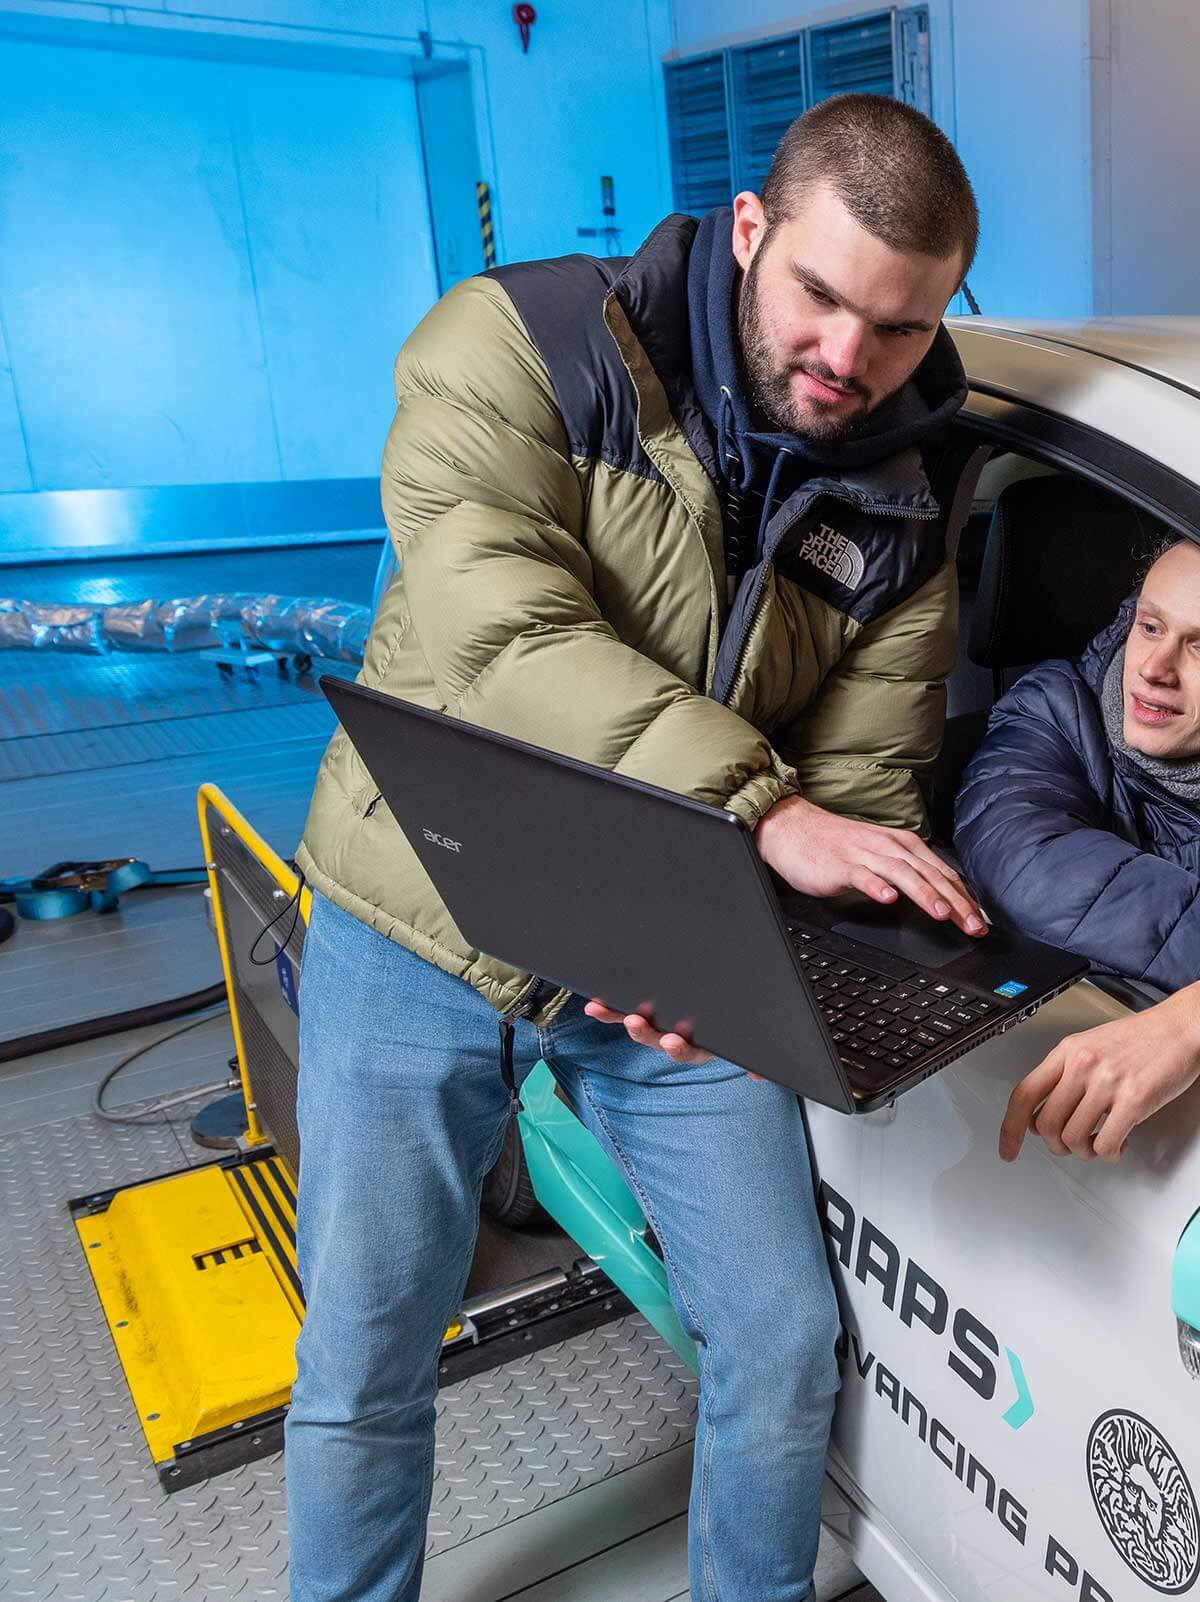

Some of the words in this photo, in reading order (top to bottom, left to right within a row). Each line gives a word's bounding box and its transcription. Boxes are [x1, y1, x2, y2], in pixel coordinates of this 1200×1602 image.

[801, 532, 842, 563] ORTH
[820, 523, 849, 550] THE
[799, 544, 838, 575] FACE
[423, 828, 462, 852] acer
